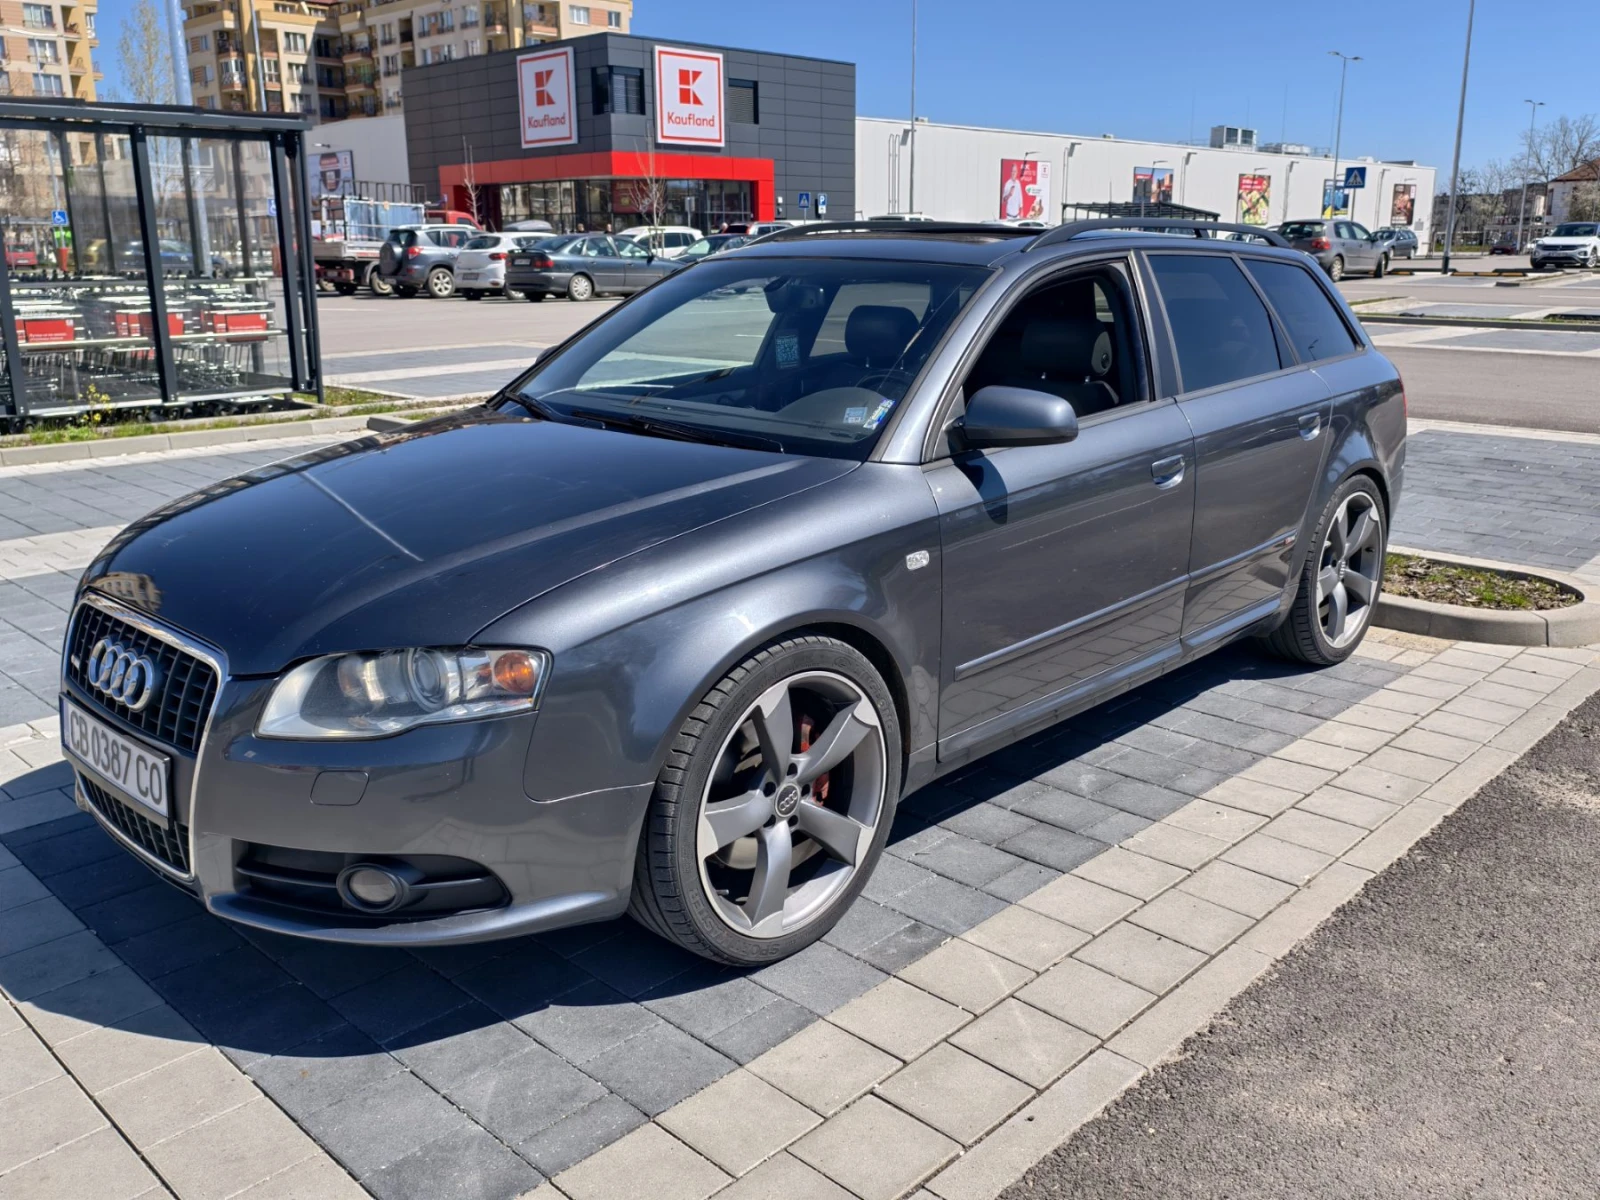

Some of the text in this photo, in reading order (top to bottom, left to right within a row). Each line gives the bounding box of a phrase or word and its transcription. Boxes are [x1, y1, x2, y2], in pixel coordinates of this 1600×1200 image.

[535, 69, 556, 107] K
[678, 69, 704, 106] K
[528, 112, 565, 128] Kaufland
[667, 111, 715, 128] Kaufland
[819, 195, 825, 205] P
[91, 727, 131, 785] 0387
